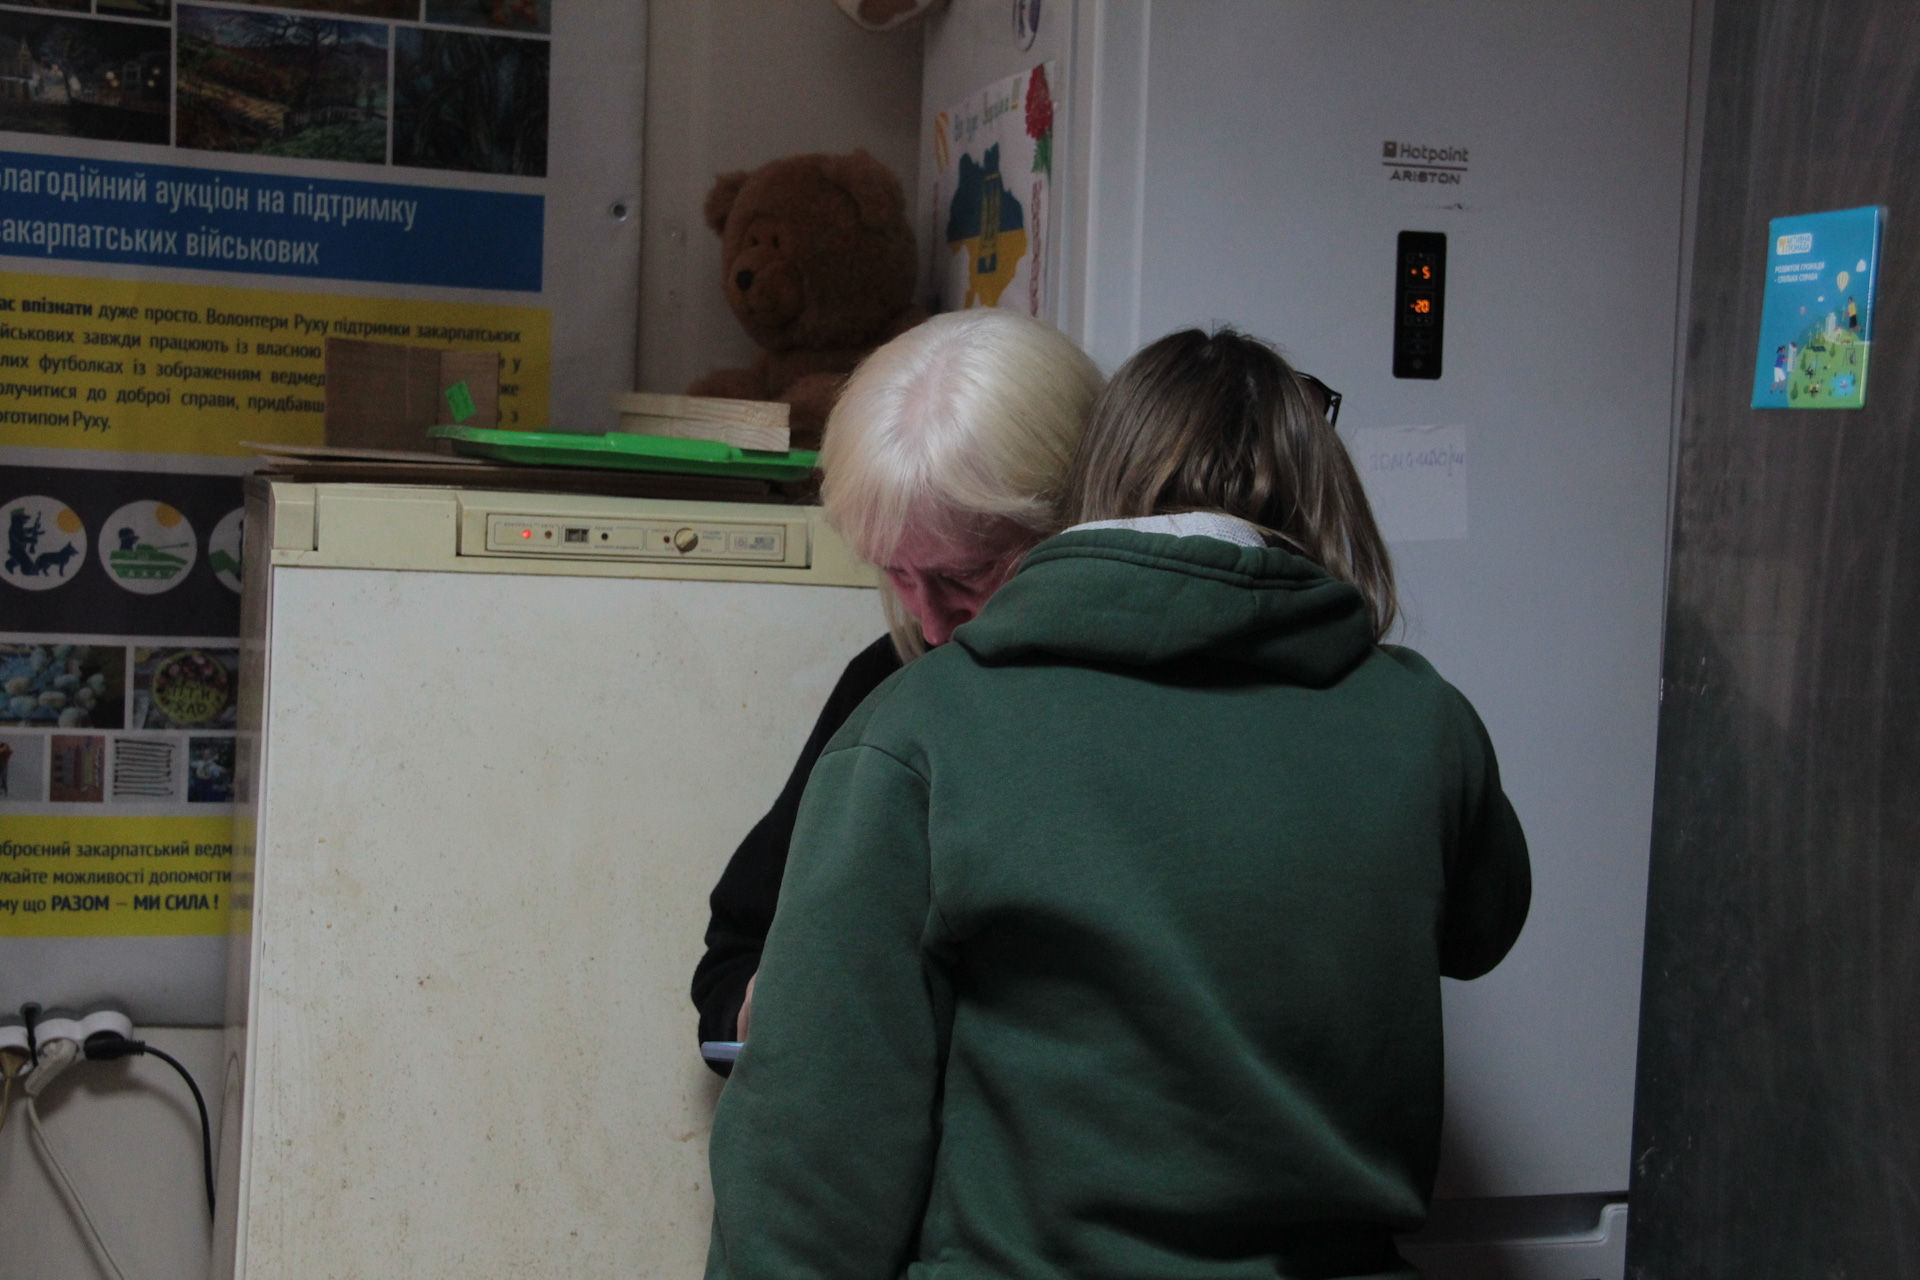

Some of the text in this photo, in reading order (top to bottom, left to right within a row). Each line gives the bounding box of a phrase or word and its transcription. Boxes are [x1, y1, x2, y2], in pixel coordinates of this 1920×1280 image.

[1400, 143, 1468, 164] Hotpoint
[1390, 169, 1461, 185] ARISTON
[0, 164, 418, 231] лагодійний аукціон на підтримку
[0, 217, 320, 265] акарпатських військових
[22, 296, 93, 316] впізнати
[98, 304, 139, 321] дуже
[206, 307, 288, 332] Волонтери
[294, 313, 330, 336] Руху
[334, 317, 411, 338] підтримки
[417, 324, 521, 343] закарпатських
[83, 331, 142, 349] завжди
[150, 336, 229, 353] працюють
[236, 338, 249, 354] із
[257, 342, 322, 359] власною
[39, 353, 124, 375] футболках
[133, 358, 147, 375] із
[156, 361, 261, 382] зображенням
[86, 388, 107, 403] до
[116, 387, 171, 408] доброї
[180, 392, 240, 411] справи,
[0, 840, 71, 860] броєний
[76, 840, 190, 860] закарпатський
[53, 867, 145, 884] можливості
[148, 871, 232, 886] допомогти
[23, 899, 47, 913] що
[51, 895, 110, 911] РАЗОМ
[133, 894, 161, 910] МИ
